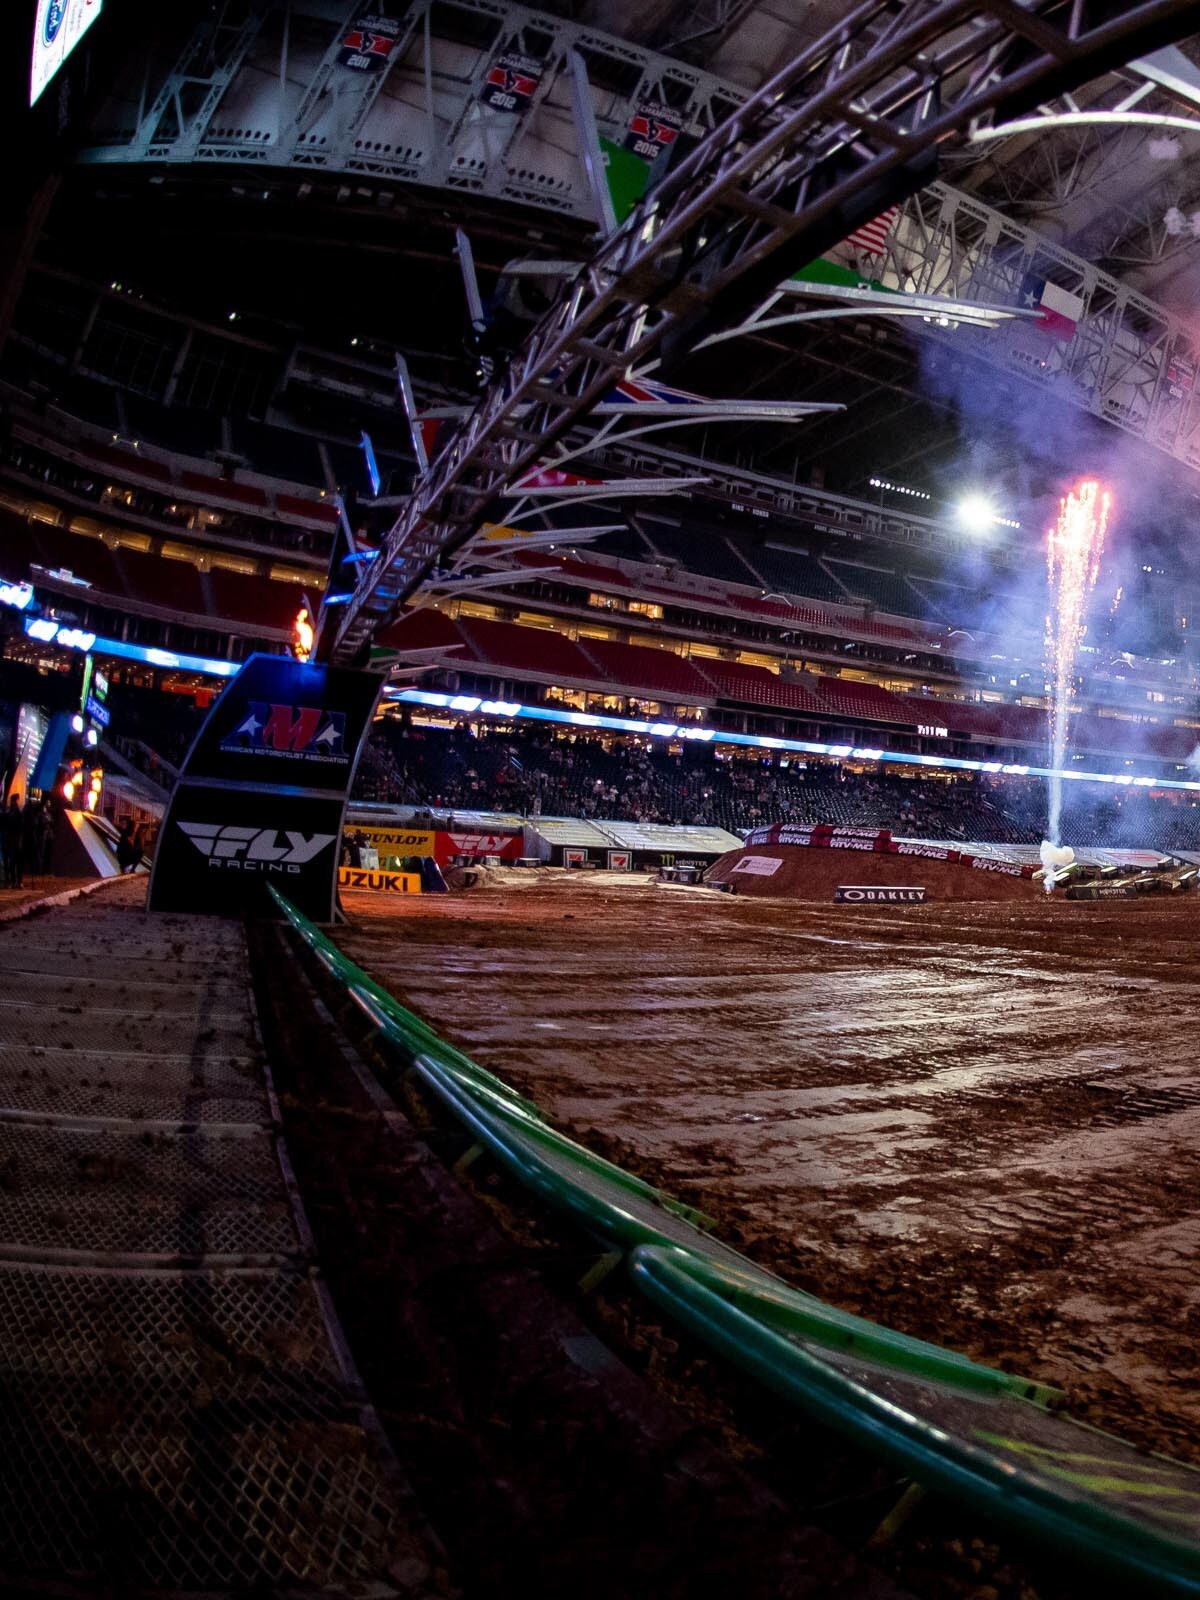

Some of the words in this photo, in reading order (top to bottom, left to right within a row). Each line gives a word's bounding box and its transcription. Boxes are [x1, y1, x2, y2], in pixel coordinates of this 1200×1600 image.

[633, 140, 660, 158] 2015
[220, 701, 350, 757] AMA
[220, 746, 254, 754] AMERICAN
[255, 749, 304, 760] MOTORCYCLIST
[305, 754, 349, 764] ASSOCIATION
[176, 821, 337, 864] FLY
[208, 858, 301, 874] RACING
[338, 872, 408, 892] UZUKI
[867, 891, 924, 900] OAKLEY
